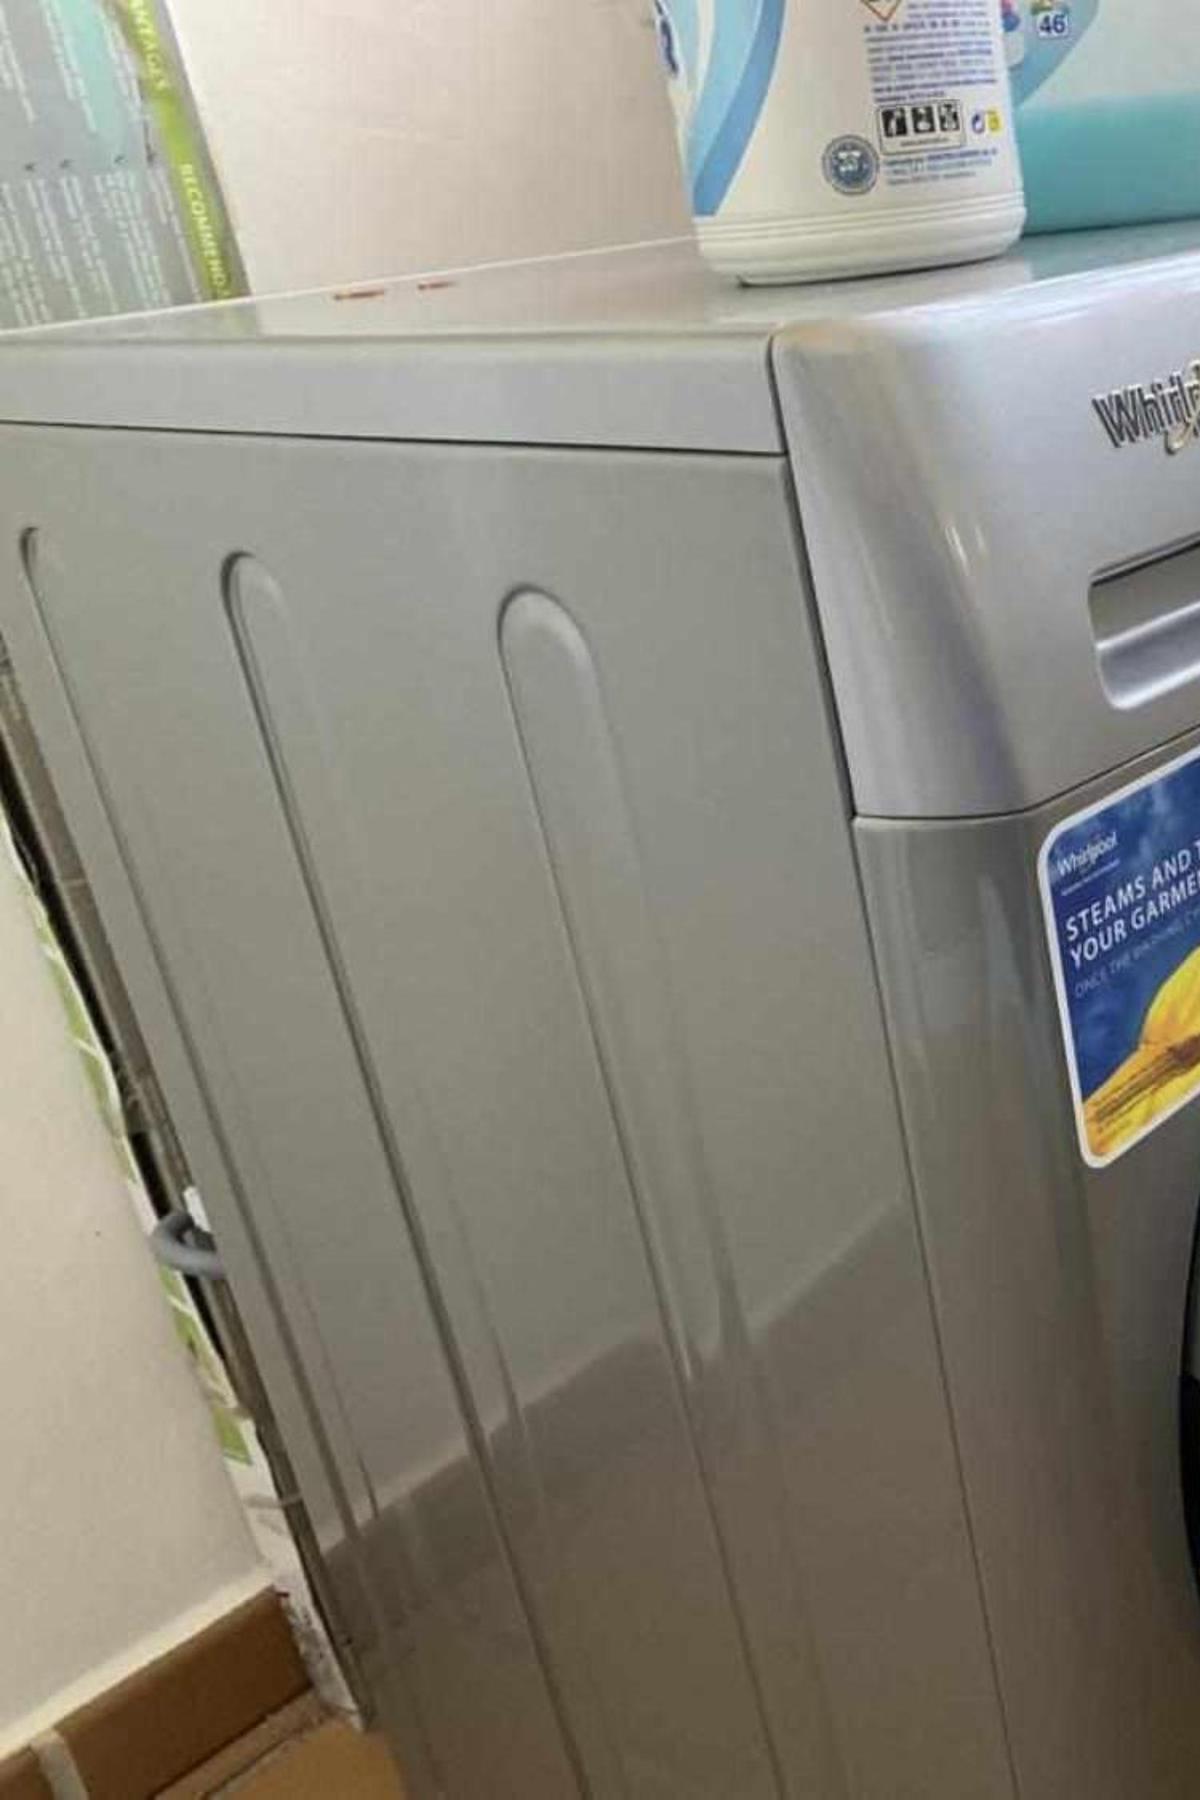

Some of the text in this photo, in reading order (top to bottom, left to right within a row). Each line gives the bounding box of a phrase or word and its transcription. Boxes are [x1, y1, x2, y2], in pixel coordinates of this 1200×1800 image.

[1038, 14, 1066, 34] 46
[1057, 831, 1118, 876] Whirlpool
[1065, 874, 1146, 942] STEAMS
[1151, 848, 1193, 890] AND
[1070, 918, 1128, 969] YOUR
